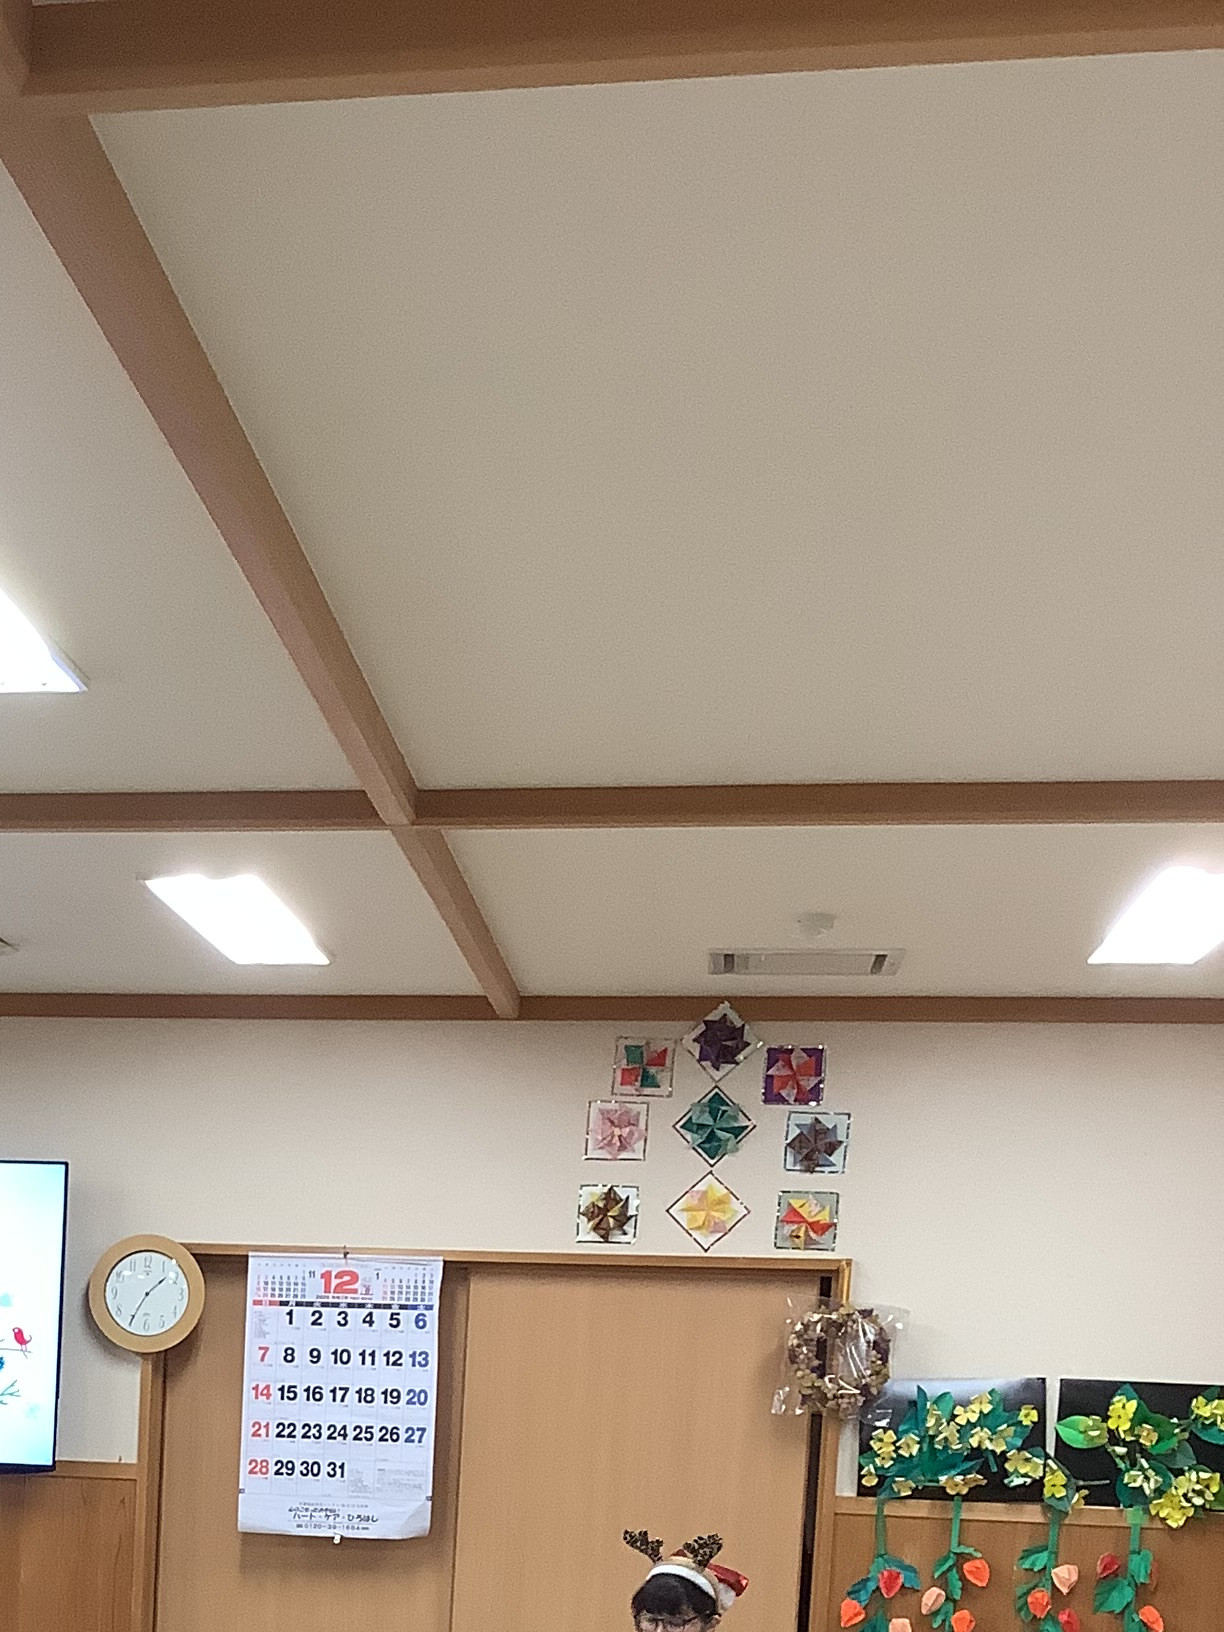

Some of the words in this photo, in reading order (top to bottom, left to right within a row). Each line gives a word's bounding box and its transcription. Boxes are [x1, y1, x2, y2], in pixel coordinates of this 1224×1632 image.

[129, 1260, 136, 1272] 11
[309, 1270, 316, 1278] 11
[376, 1272, 380, 1280] 1
[320, 1270, 359, 1294] 12
[111, 1287, 117, 1300] 9
[178, 1287, 184, 1301] 3
[143, 1318, 150, 1332] 6
[159, 1315, 165, 1328] 5
[286, 1309, 294, 1325] 1
[310, 1310, 324, 1326] 2
[336, 1311, 348, 1327] 3
[362, 1312, 374, 1327] 4
[388, 1312, 400, 1328] 5
[414, 1313, 428, 1329] 6
[258, 1347, 270, 1362] 7
[282, 1347, 296, 1363] 8
[308, 1348, 322, 1364] 9
[330, 1349, 352, 1365] 10
[358, 1349, 376, 1366] 11
[382, 1350, 404, 1366] 12
[408, 1351, 430, 1367] 13
[252, 1384, 272, 1400] 14
[278, 1385, 298, 1401] 15
[302, 1386, 324, 1402] 16
[330, 1387, 350, 1402] 17
[354, 1387, 376, 1403] 18
[380, 1388, 402, 1404] 19
[406, 1389, 428, 1406] 20
[252, 1422, 270, 1437] 21
[276, 1422, 296, 1438] 22
[300, 1423, 322, 1440] 23
[326, 1424, 348, 1440] 24
[352, 1425, 374, 1442] 25
[378, 1426, 400, 1442] 26
[404, 1427, 426, 1443] 27
[248, 1459, 270, 1475] 28
[274, 1460, 296, 1476] 29
[300, 1461, 322, 1477] 30
[326, 1462, 346, 1478] 31
